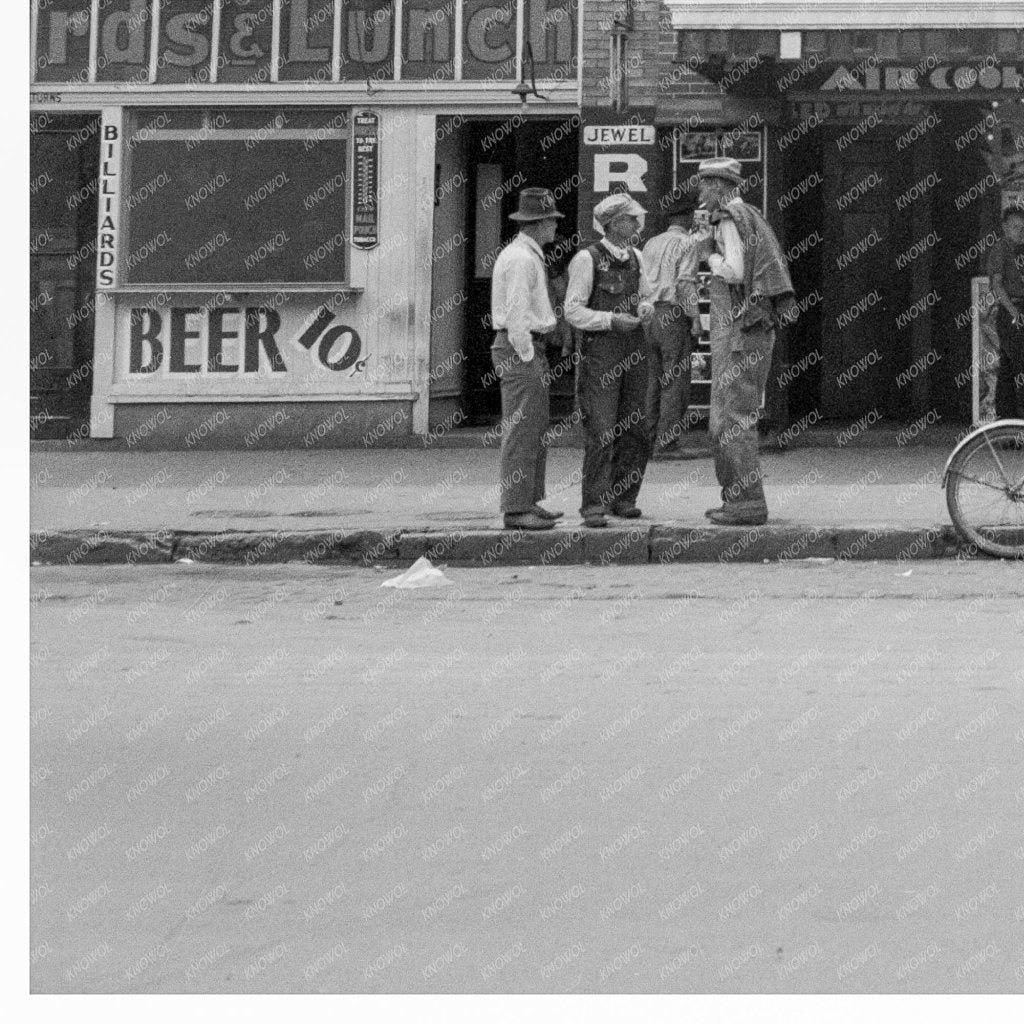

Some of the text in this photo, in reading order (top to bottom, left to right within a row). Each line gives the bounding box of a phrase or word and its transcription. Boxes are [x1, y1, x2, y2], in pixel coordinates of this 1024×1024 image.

[231, 12, 267, 66] &
[818, 65, 921, 90] AIR
[587, 128, 651, 143] JEWEL
[593, 153, 648, 192] R
[101, 126, 118, 286] BILLIARDS
[129, 307, 287, 374] BEER
